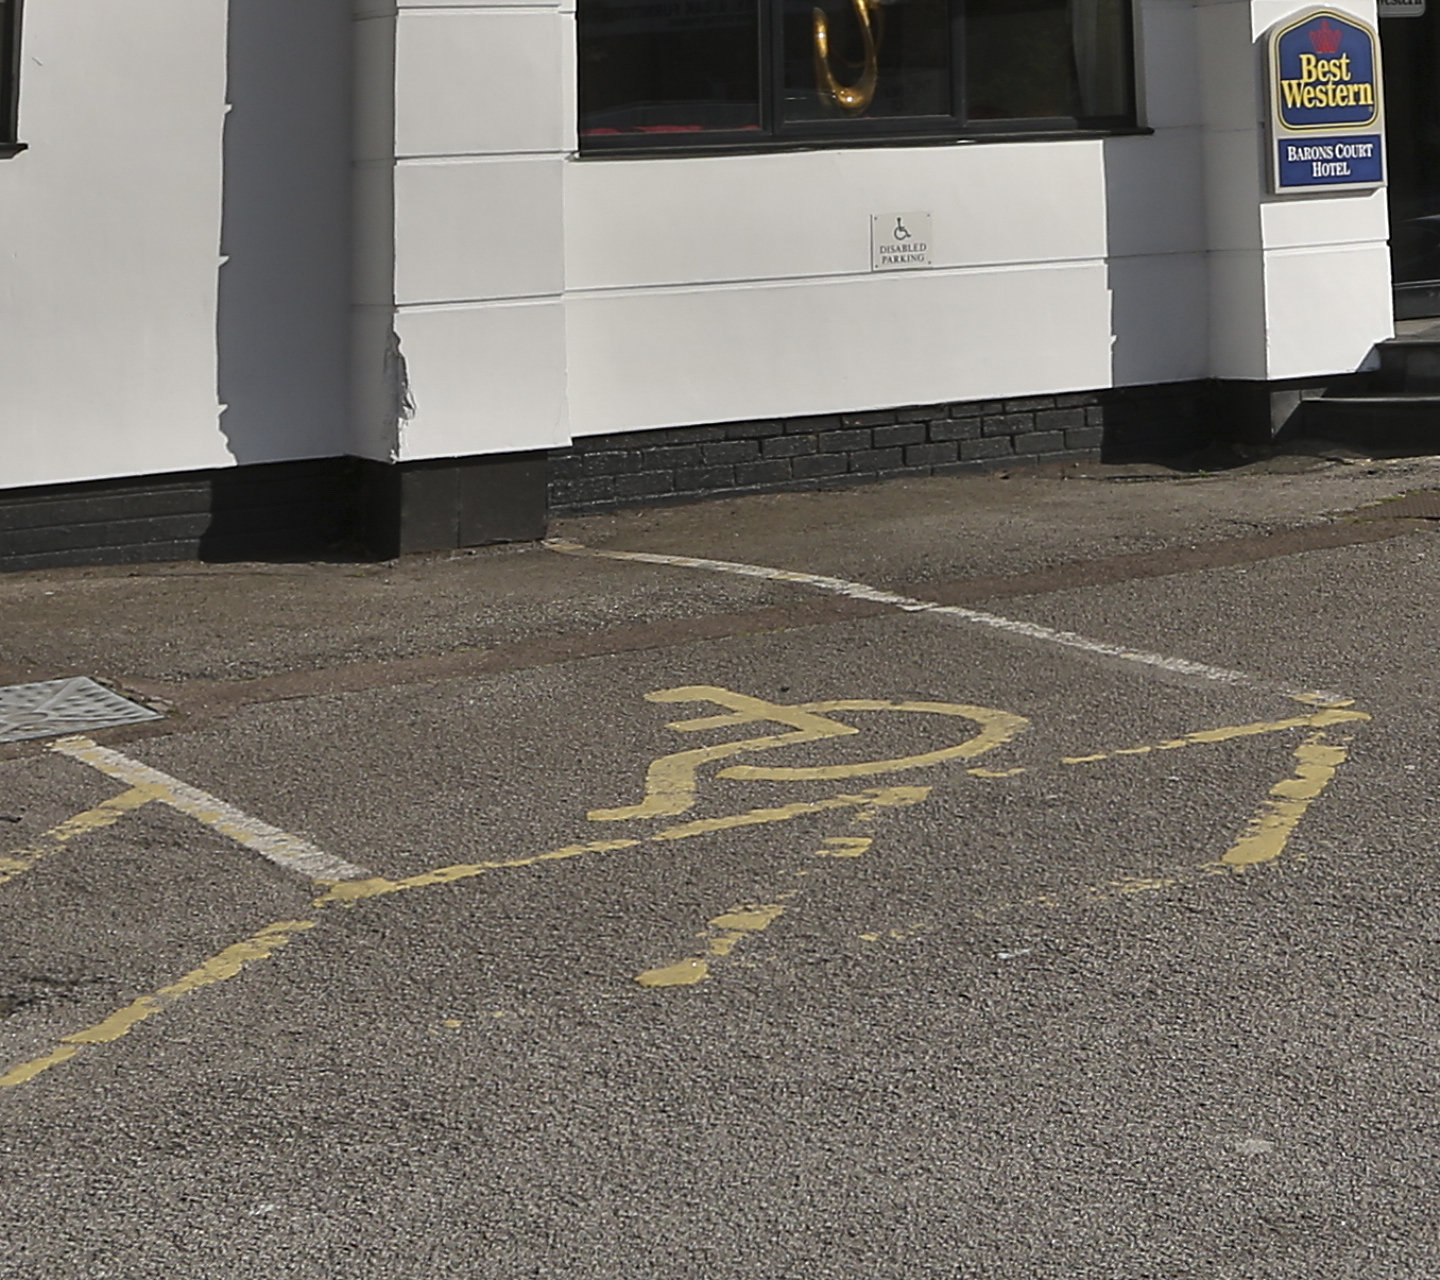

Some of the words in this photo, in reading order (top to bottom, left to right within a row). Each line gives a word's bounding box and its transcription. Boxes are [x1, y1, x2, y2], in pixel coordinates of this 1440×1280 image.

[1298, 53, 1351, 83] Best
[1280, 74, 1374, 109] Western
[1287, 145, 1333, 161] BARONS
[1335, 143, 1373, 158] COURT
[1312, 161, 1351, 177] HOTEL
[879, 243, 927, 254] DISABLED
[881, 253, 925, 264] PARKING
